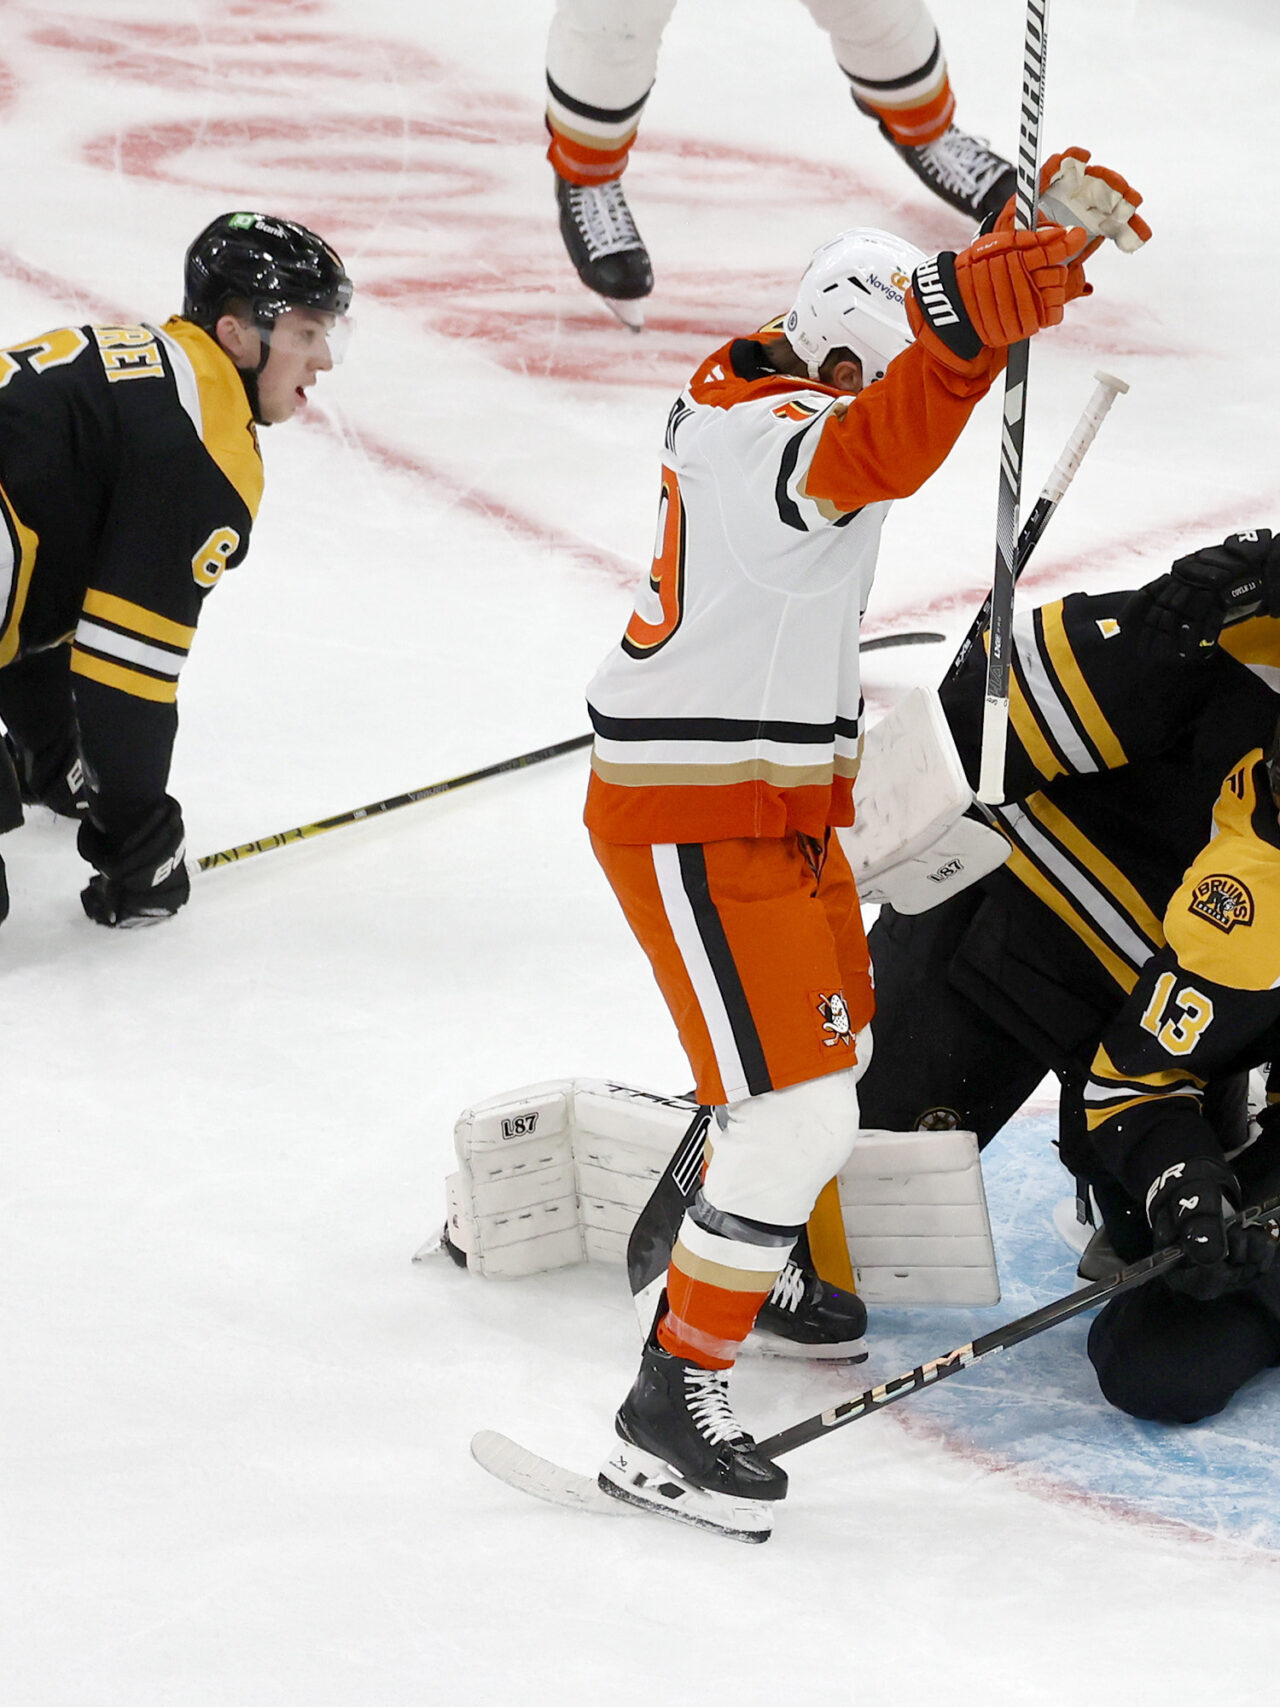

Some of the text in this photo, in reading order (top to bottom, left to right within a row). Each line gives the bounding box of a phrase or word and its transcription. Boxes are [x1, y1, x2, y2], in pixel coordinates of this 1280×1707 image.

[254, 221, 288, 239] Bank
[93, 325, 166, 383] REI
[191, 525, 241, 589] 6
[1198, 879, 1249, 920] BRUINS
[1139, 970, 1215, 1057] 13
[501, 1112, 540, 1140] L87
[820, 1342, 975, 1428] CCM
